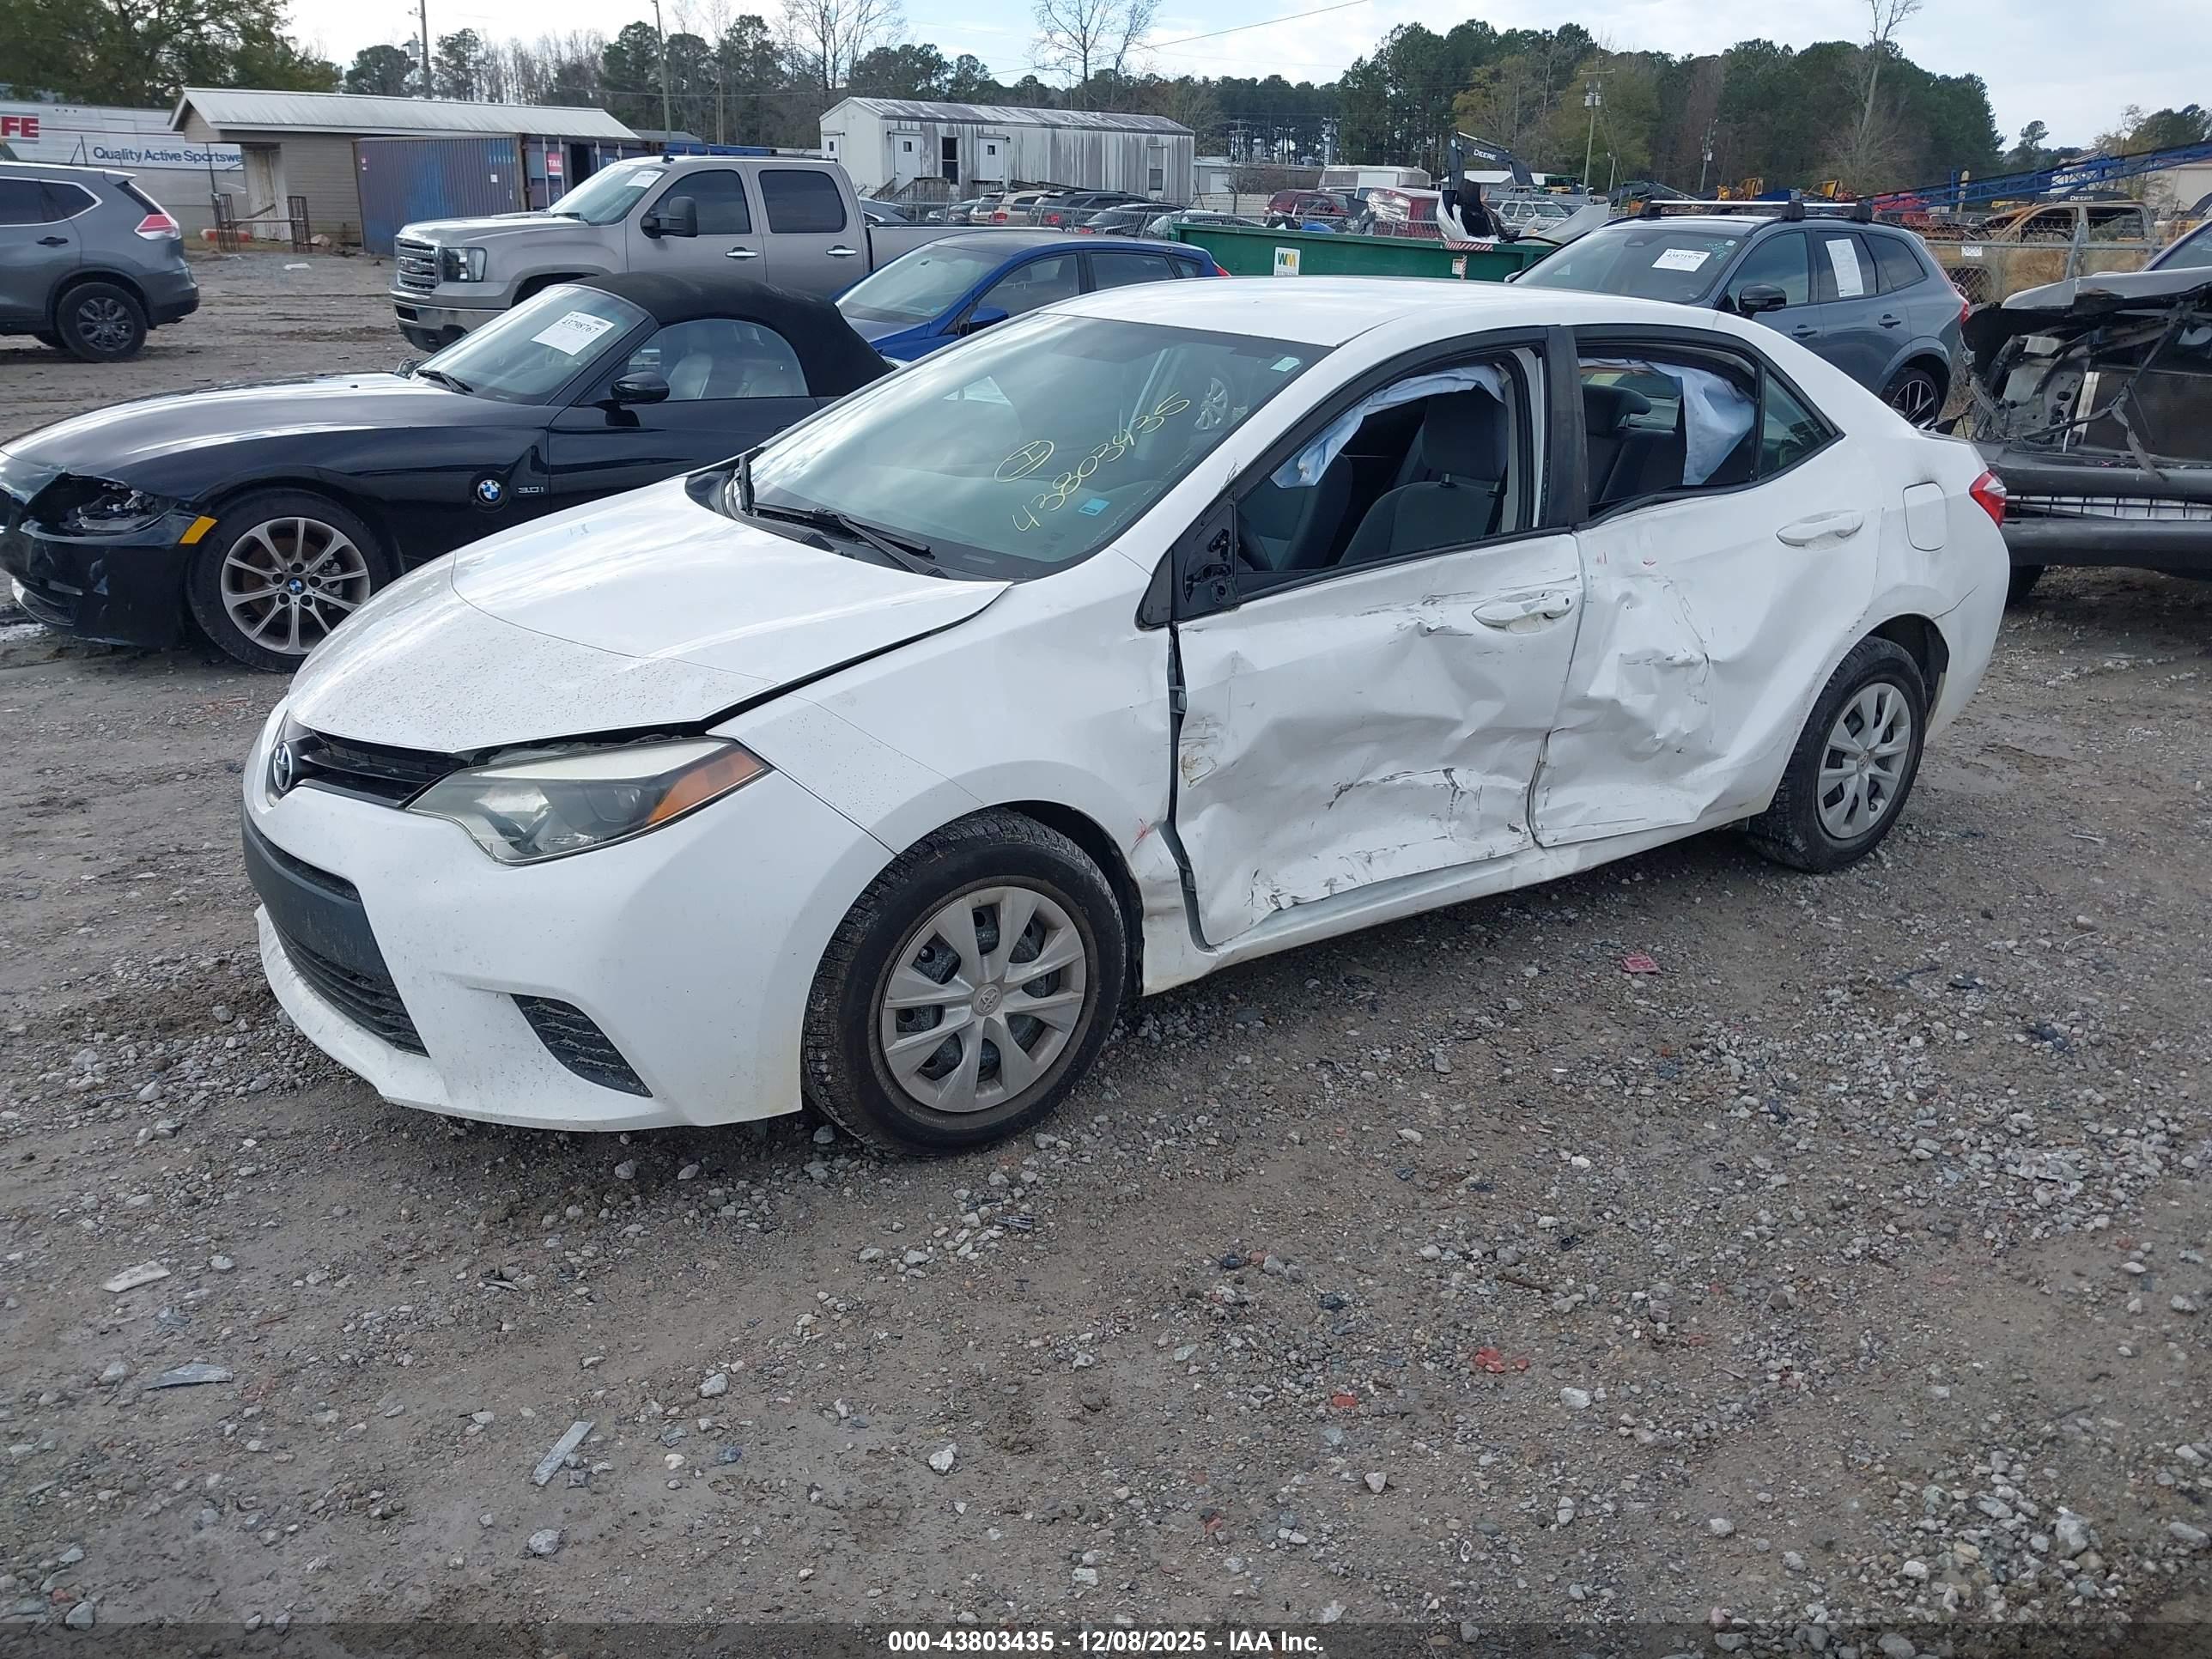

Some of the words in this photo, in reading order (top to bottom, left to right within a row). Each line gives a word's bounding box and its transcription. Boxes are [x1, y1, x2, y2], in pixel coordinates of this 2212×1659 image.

[2, 117, 39, 137] FE
[93, 147, 142, 162] Quality
[144, 149, 181, 161] Active
[1278, 252, 1296, 267] WM
[1012, 392, 1190, 532] 43803435
